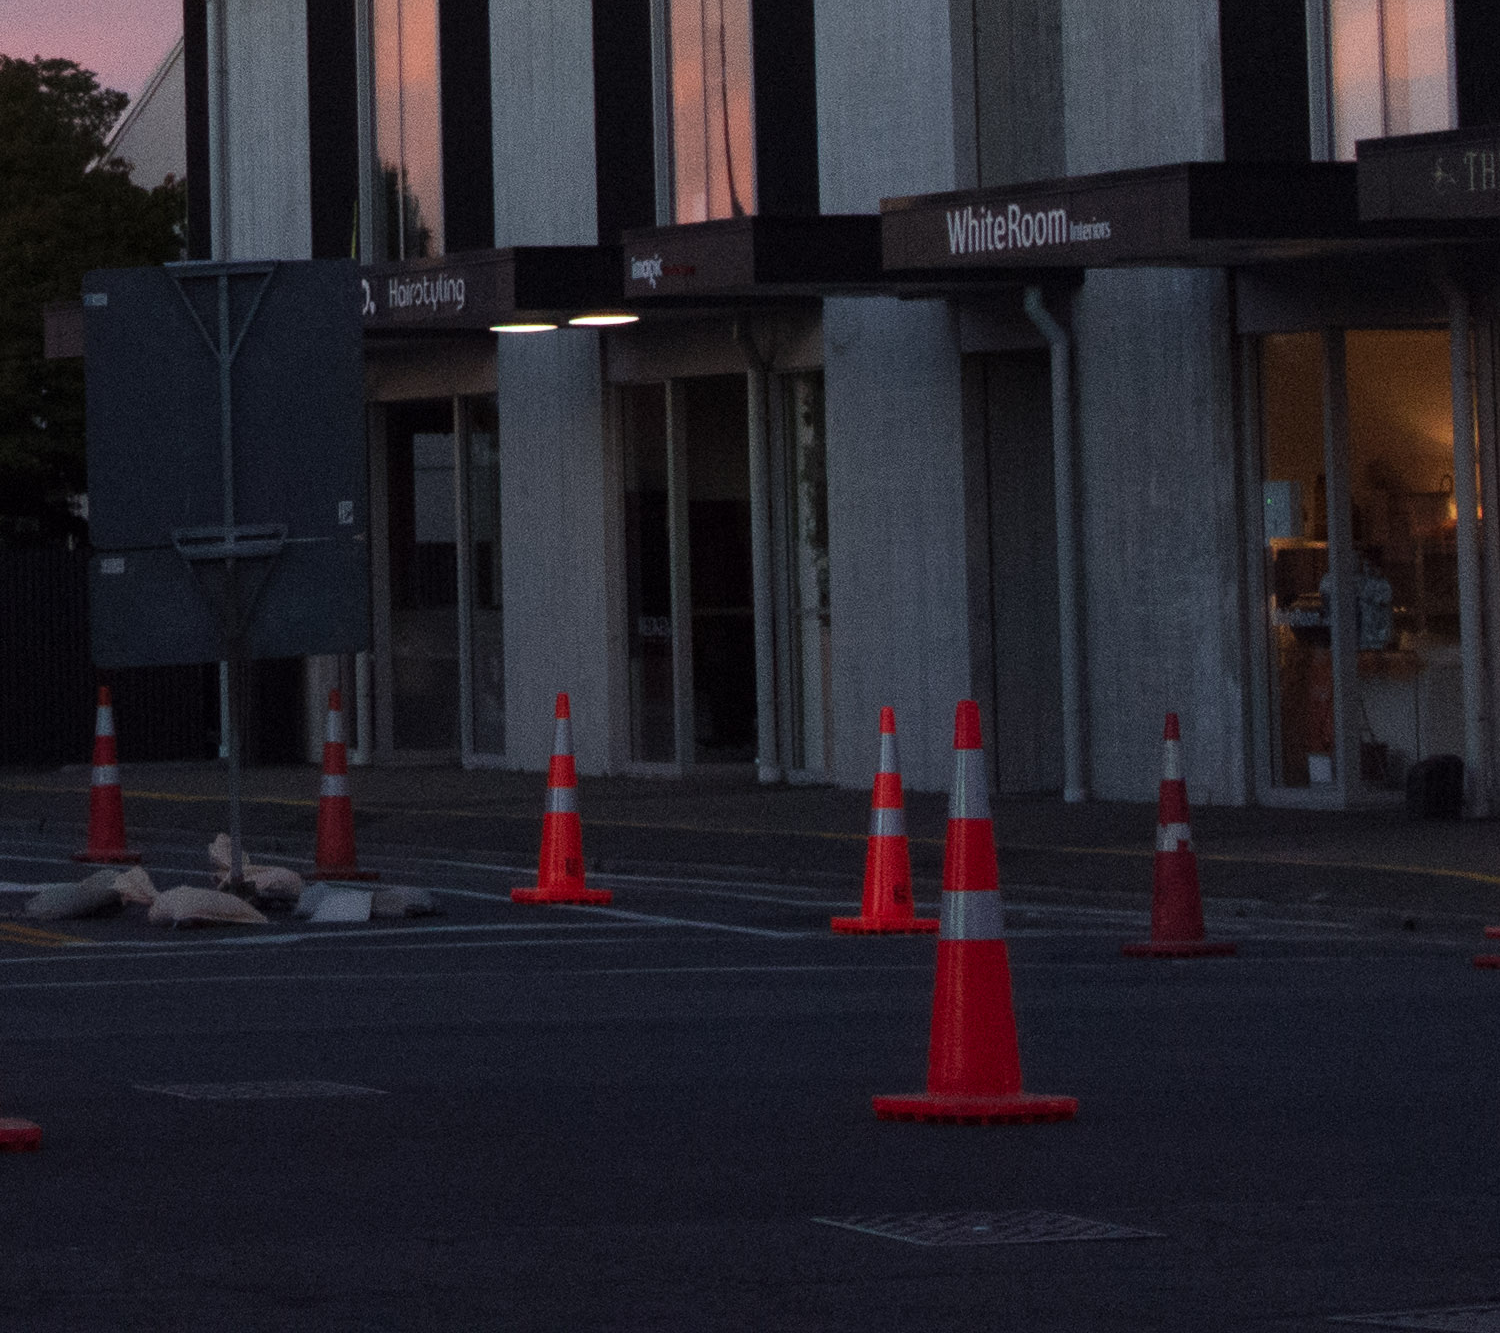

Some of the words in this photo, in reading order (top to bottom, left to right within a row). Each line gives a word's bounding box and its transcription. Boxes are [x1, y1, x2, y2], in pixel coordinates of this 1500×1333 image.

[946, 203, 1067, 255] WhiteRoom
[1070, 216, 1112, 242] Interiors
[388, 277, 466, 311] Hairstyling
